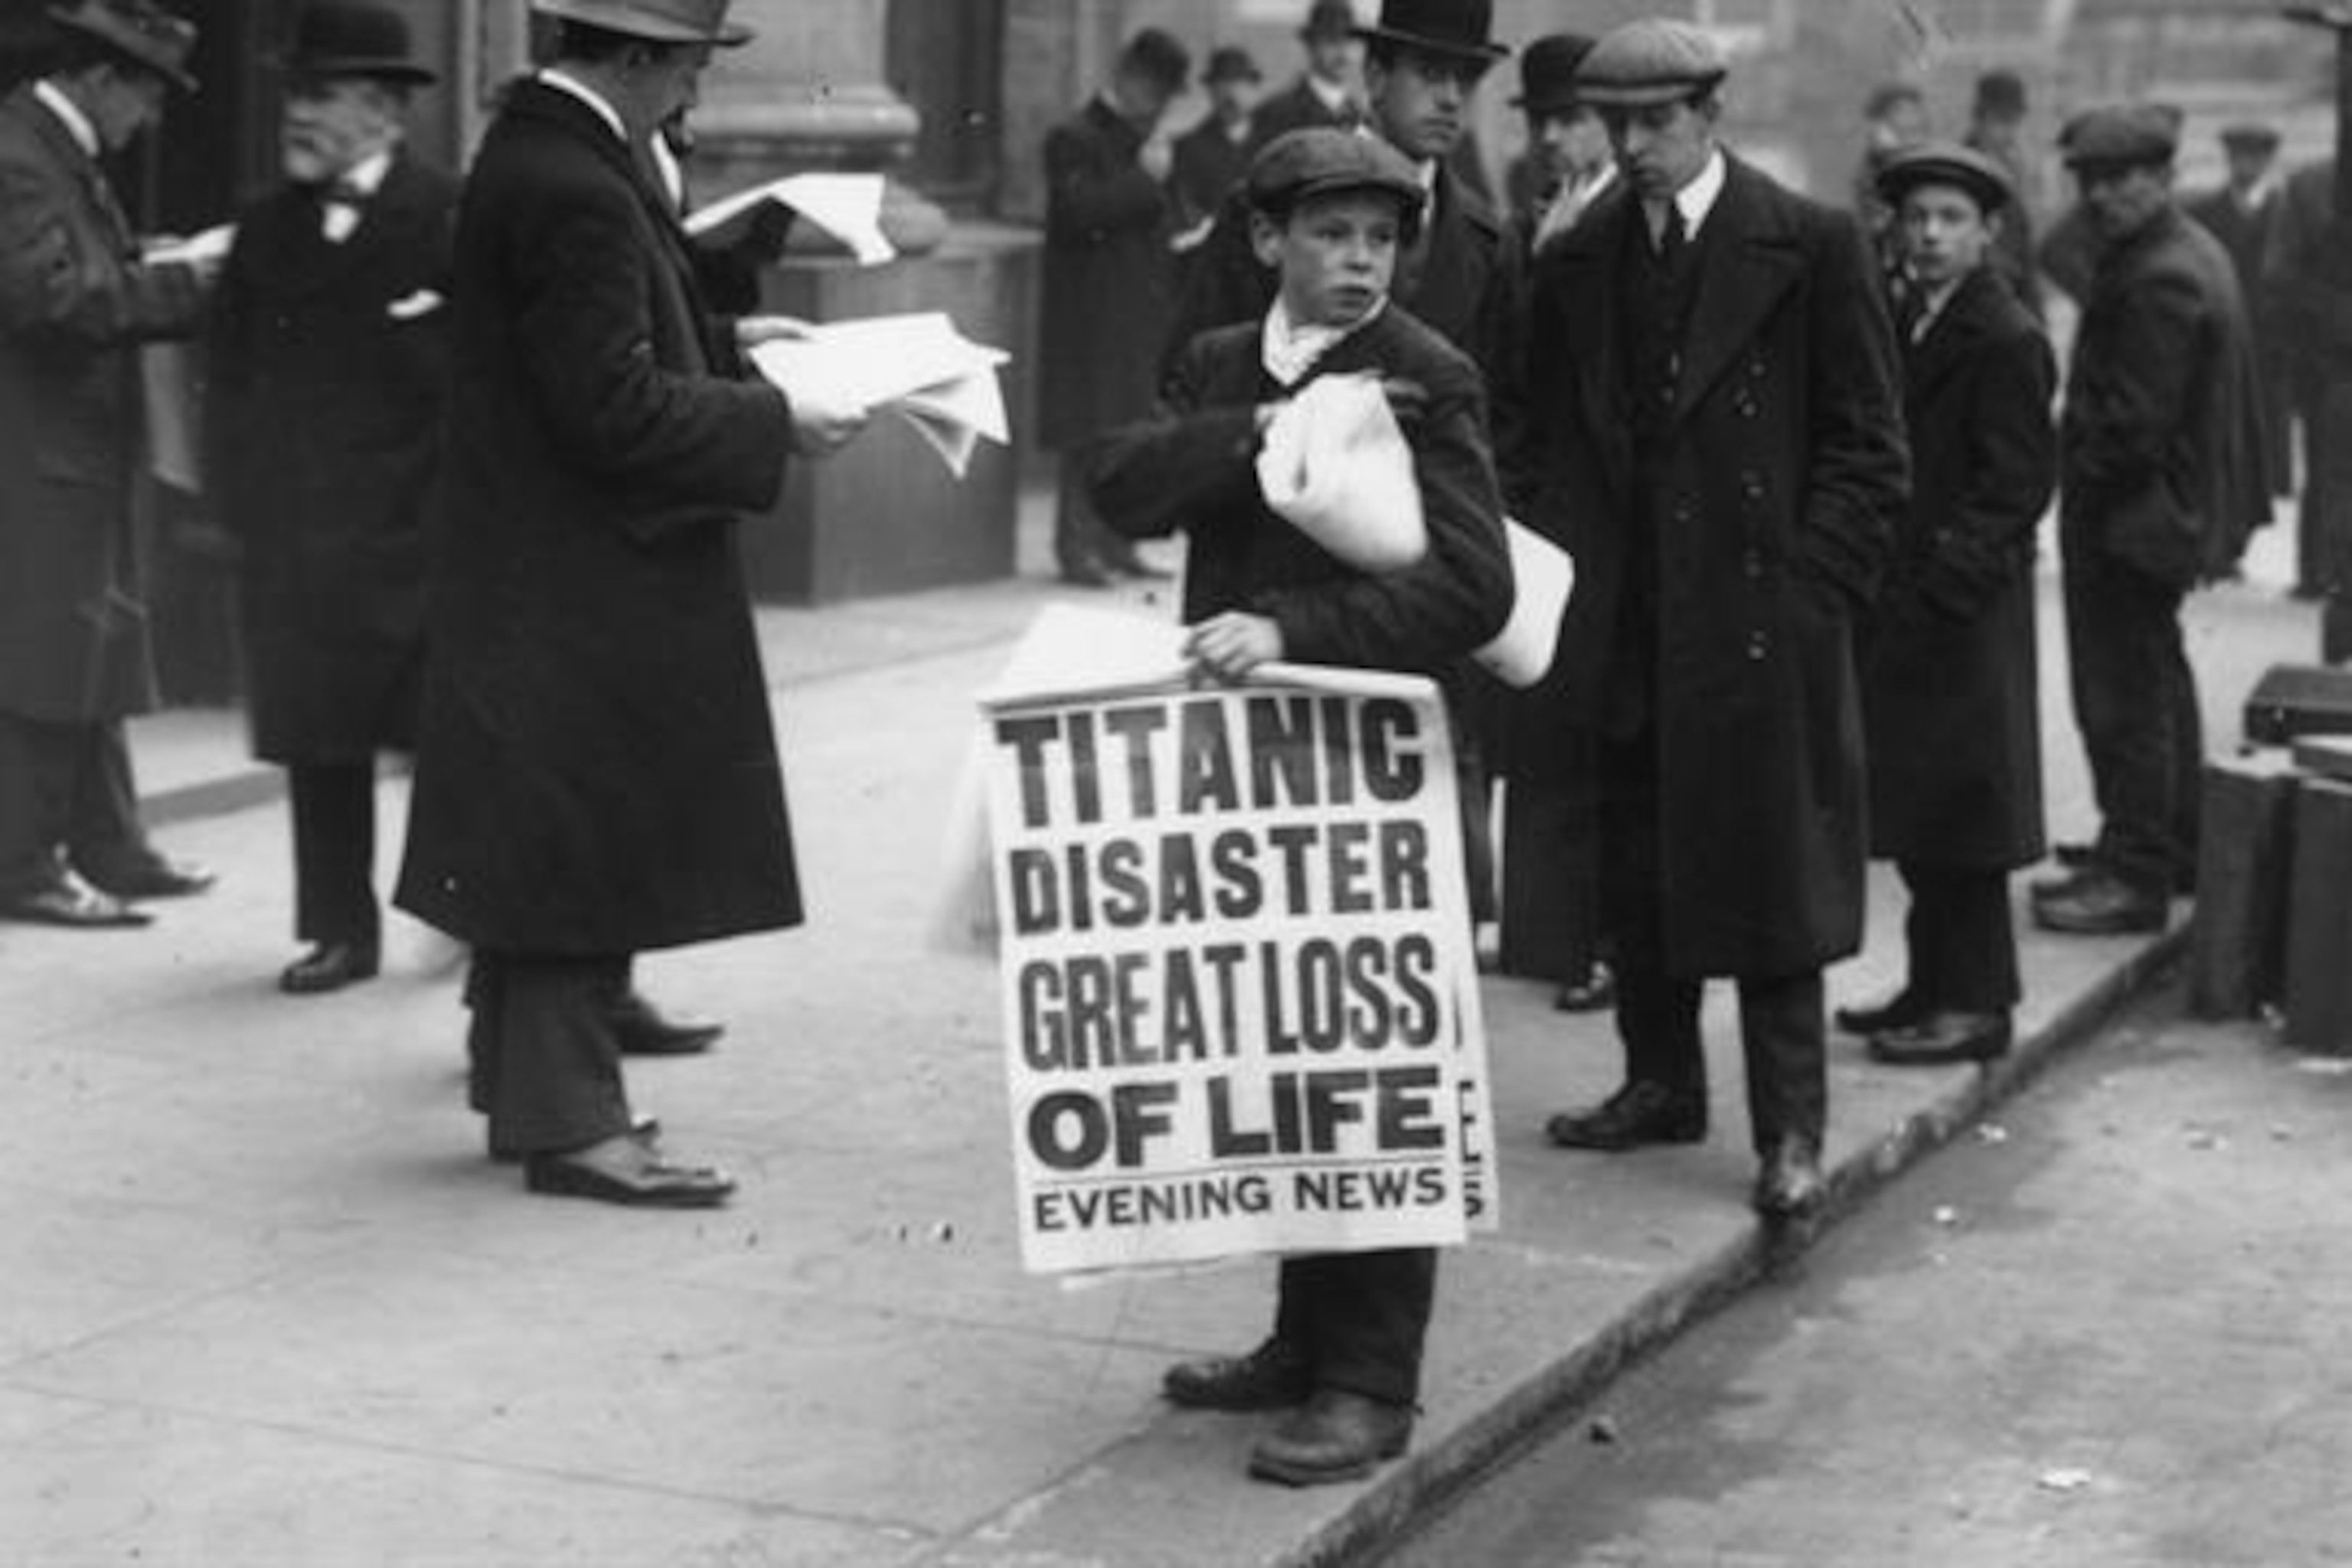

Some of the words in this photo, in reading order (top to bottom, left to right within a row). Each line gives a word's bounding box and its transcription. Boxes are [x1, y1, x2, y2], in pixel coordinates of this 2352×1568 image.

[996, 696, 1424, 826] TITANIC
[1010, 819, 1431, 935] DISASTER
[1020, 945, 1246, 1070] GREAT
[1263, 934, 1439, 1054] LOSS
[1027, 1083, 1178, 1170] OF
[1207, 1065, 1445, 1157] LIFE
[1034, 1178, 1271, 1230] EVENING
[1295, 1168, 1446, 1212] NEWS
